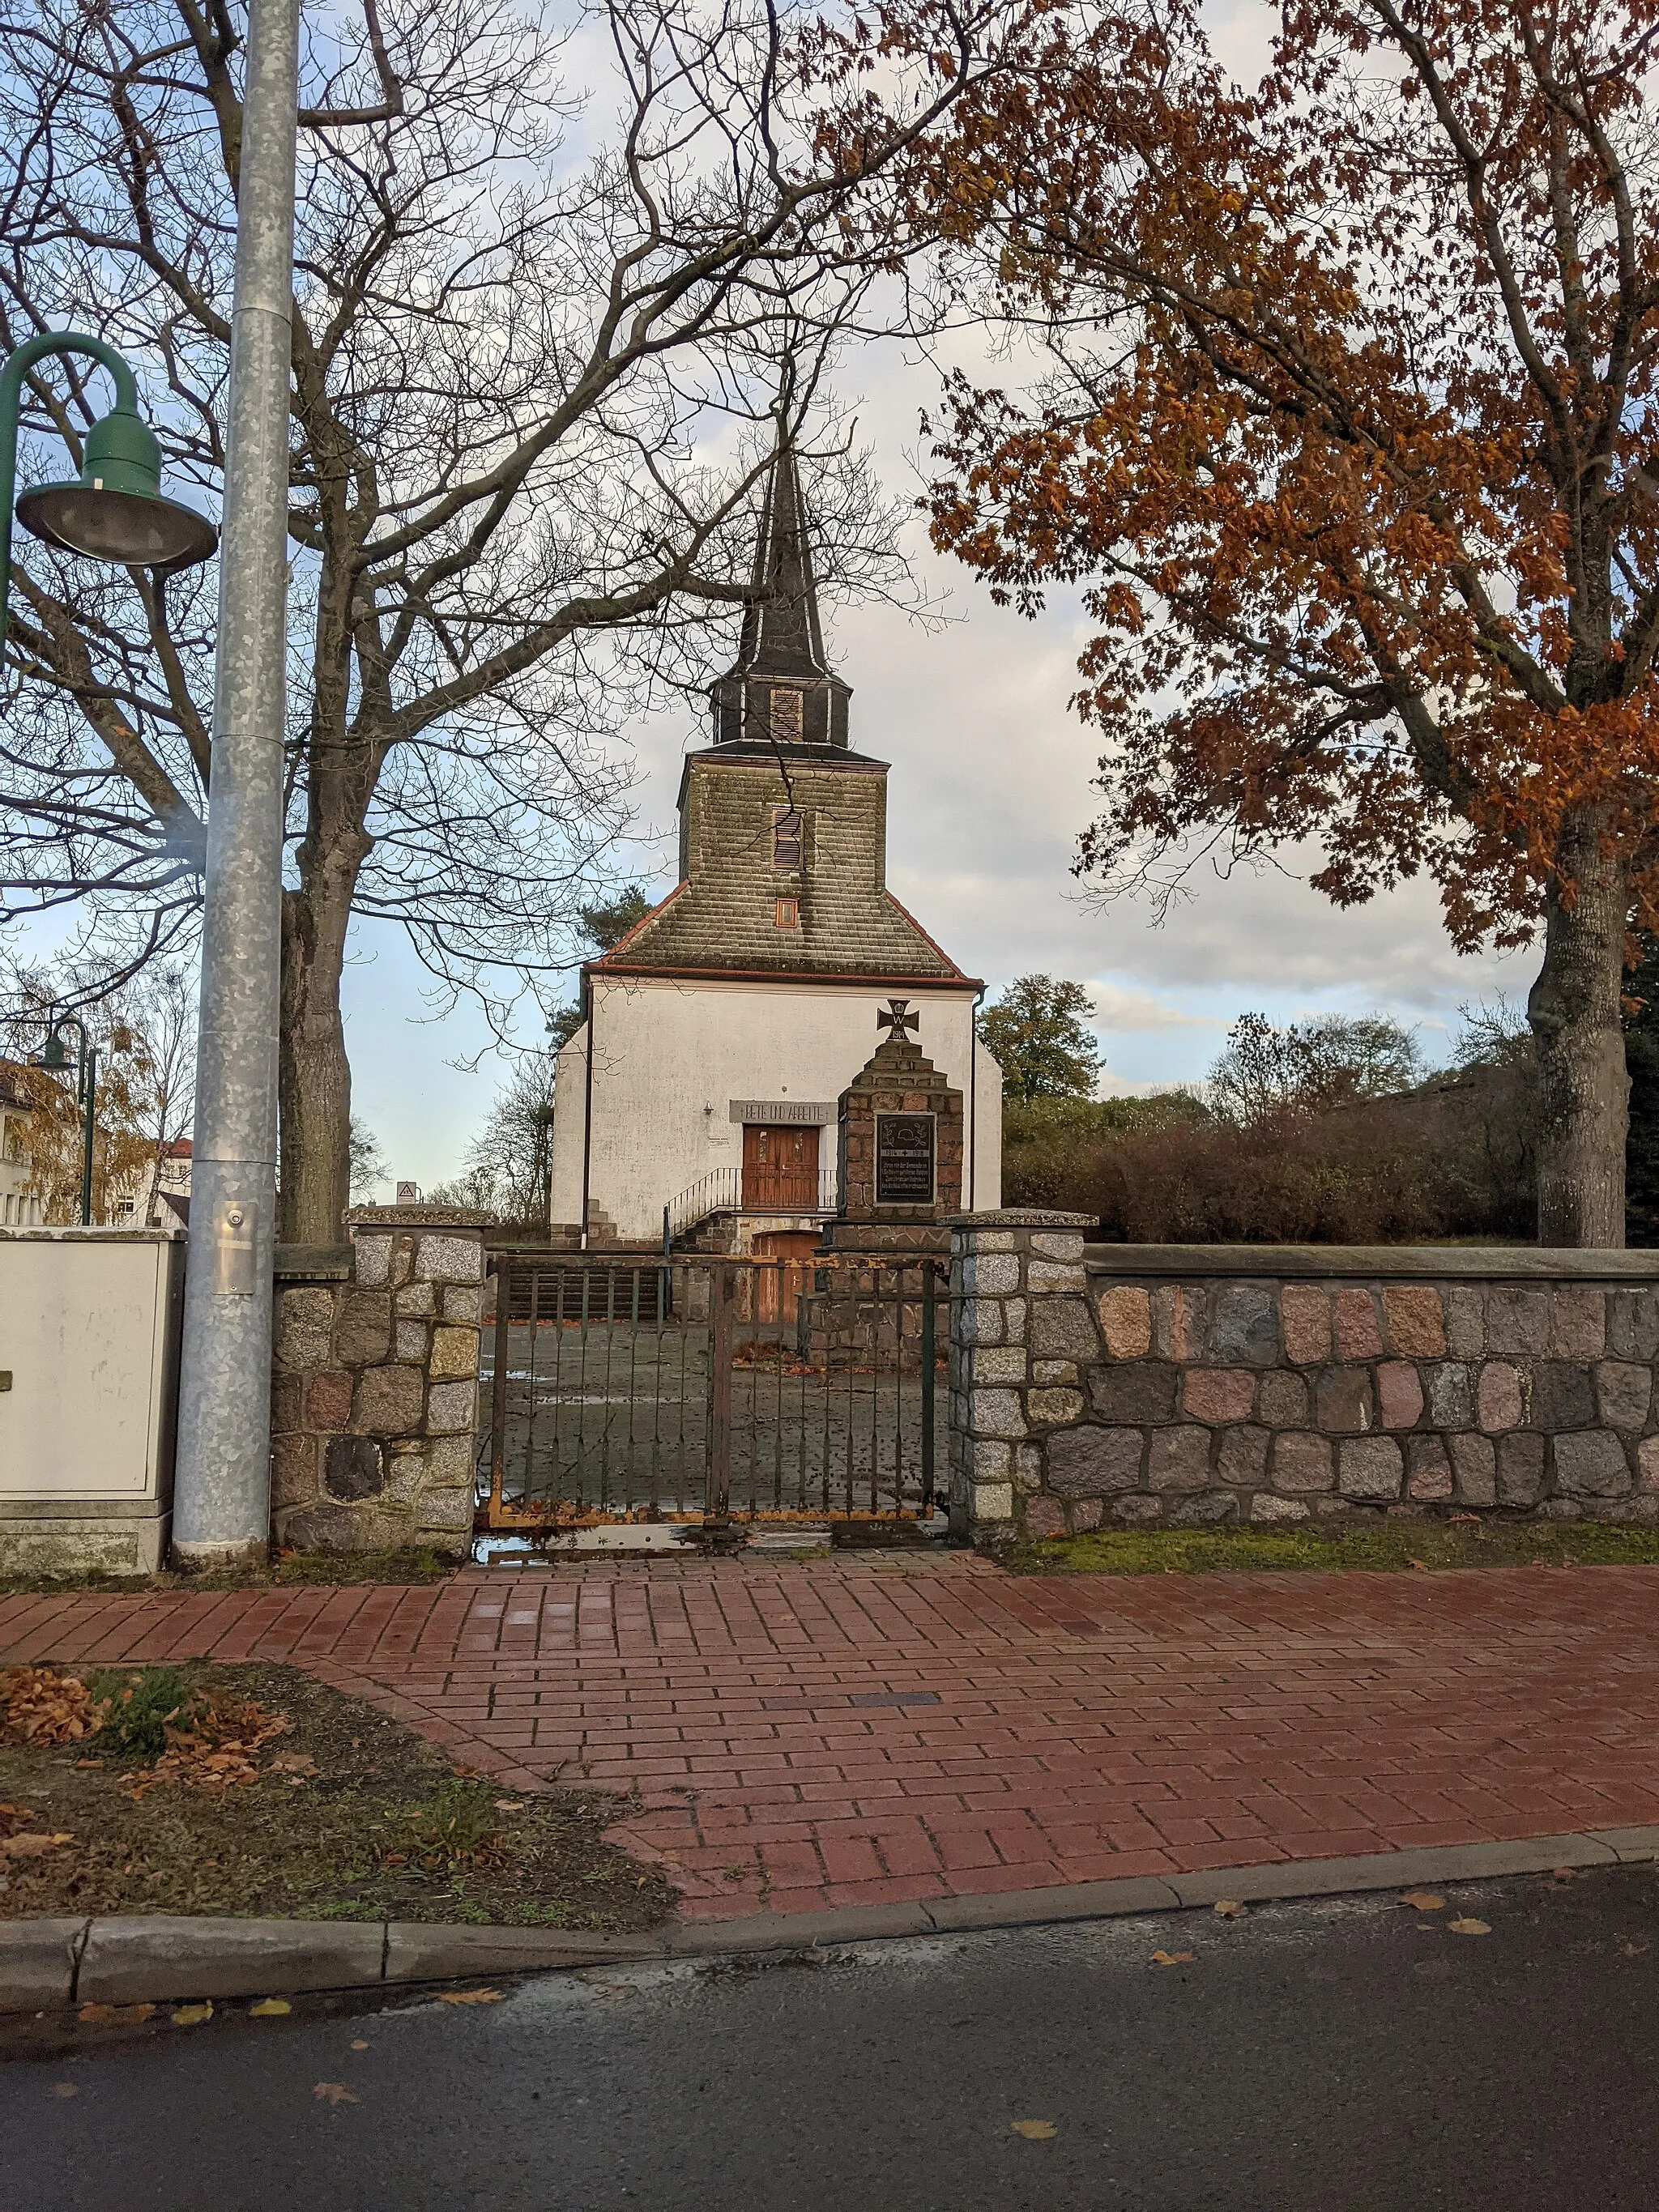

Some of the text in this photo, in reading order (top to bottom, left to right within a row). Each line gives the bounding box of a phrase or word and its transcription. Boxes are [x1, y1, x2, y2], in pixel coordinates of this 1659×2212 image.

[745, 1104, 823, 1121] BETE UND ARBEITE
